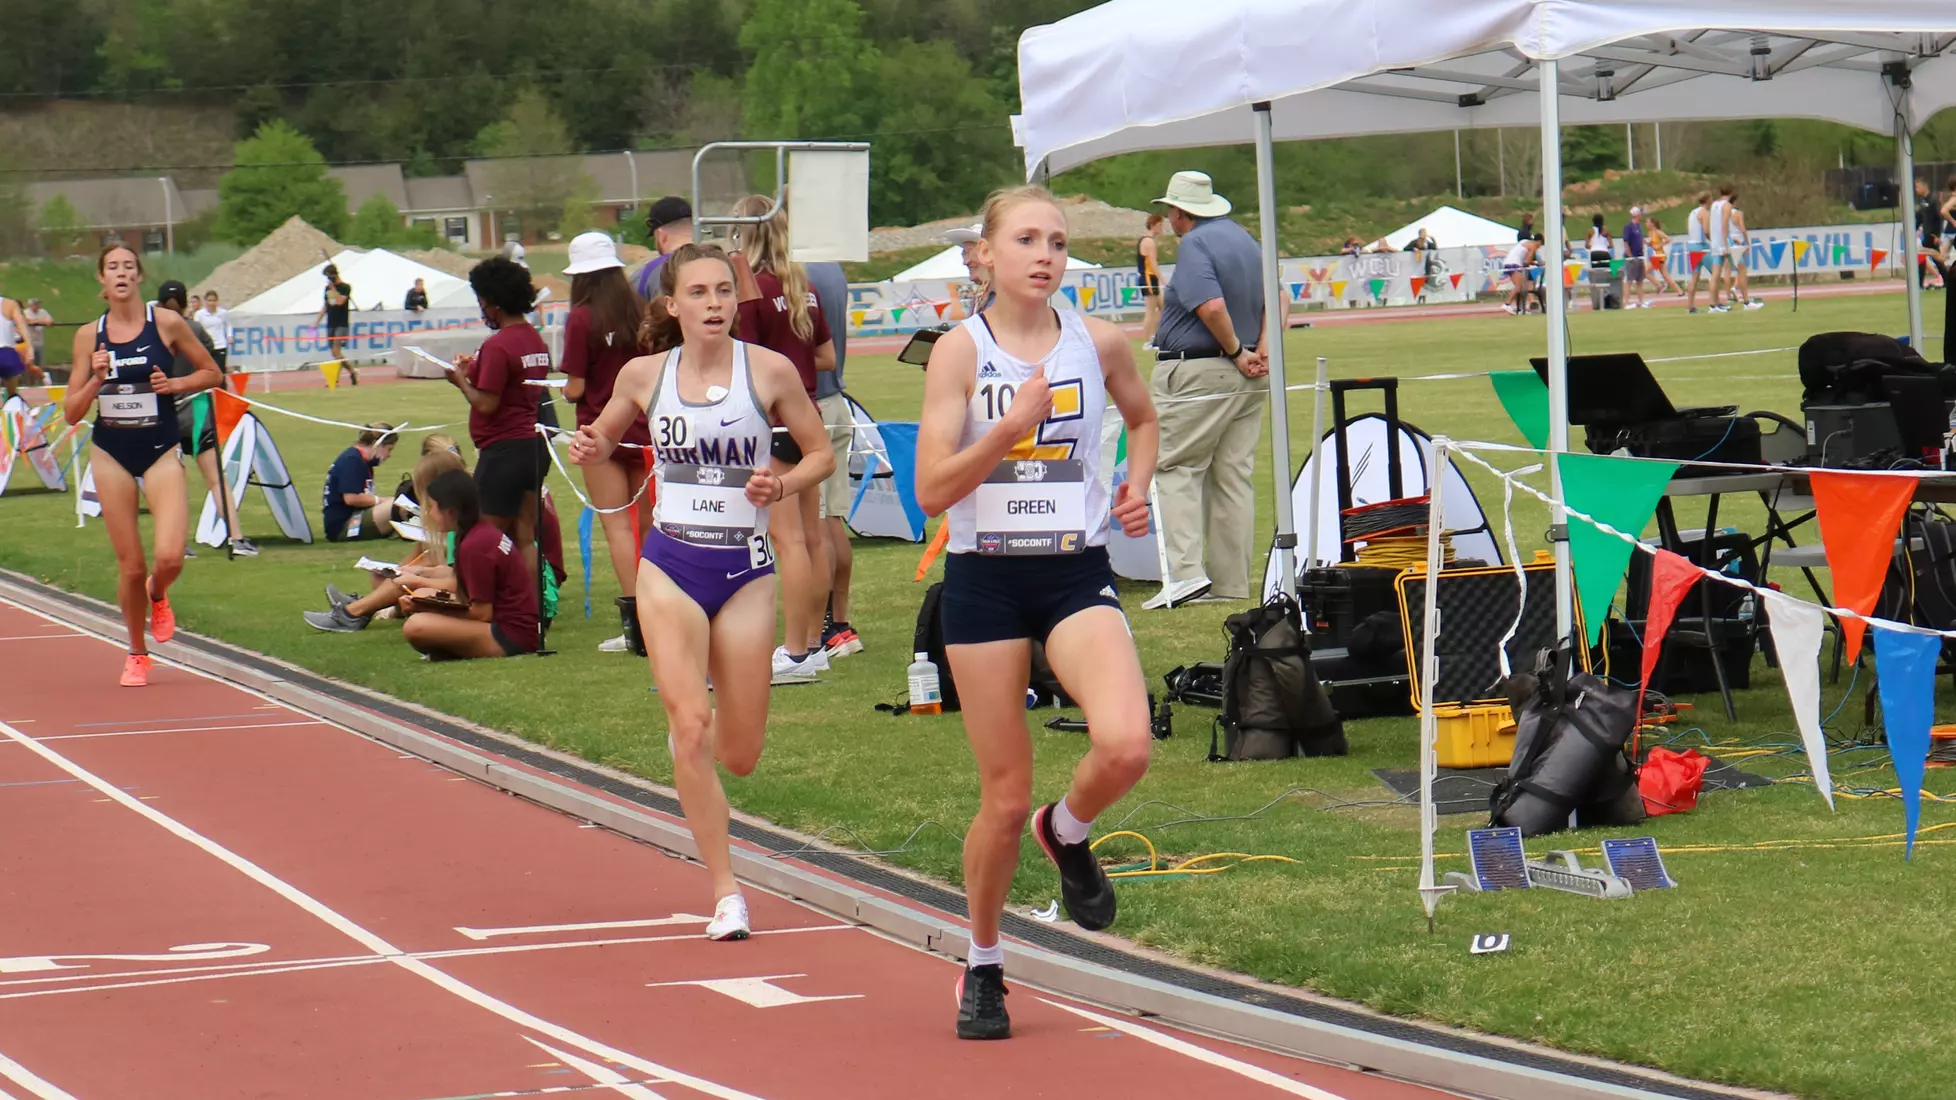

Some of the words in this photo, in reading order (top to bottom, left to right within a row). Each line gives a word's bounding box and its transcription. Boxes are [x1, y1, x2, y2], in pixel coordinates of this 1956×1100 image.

[112, 402, 143, 411] NELSON
[659, 415, 687, 447] 30
[692, 498, 726, 513] LANE
[1007, 499, 1056, 514] GREEN
[686, 530, 724, 540] #SOCONTF
[1060, 533, 1078, 551] C
[1008, 538, 1052, 548] #SOCONTF
